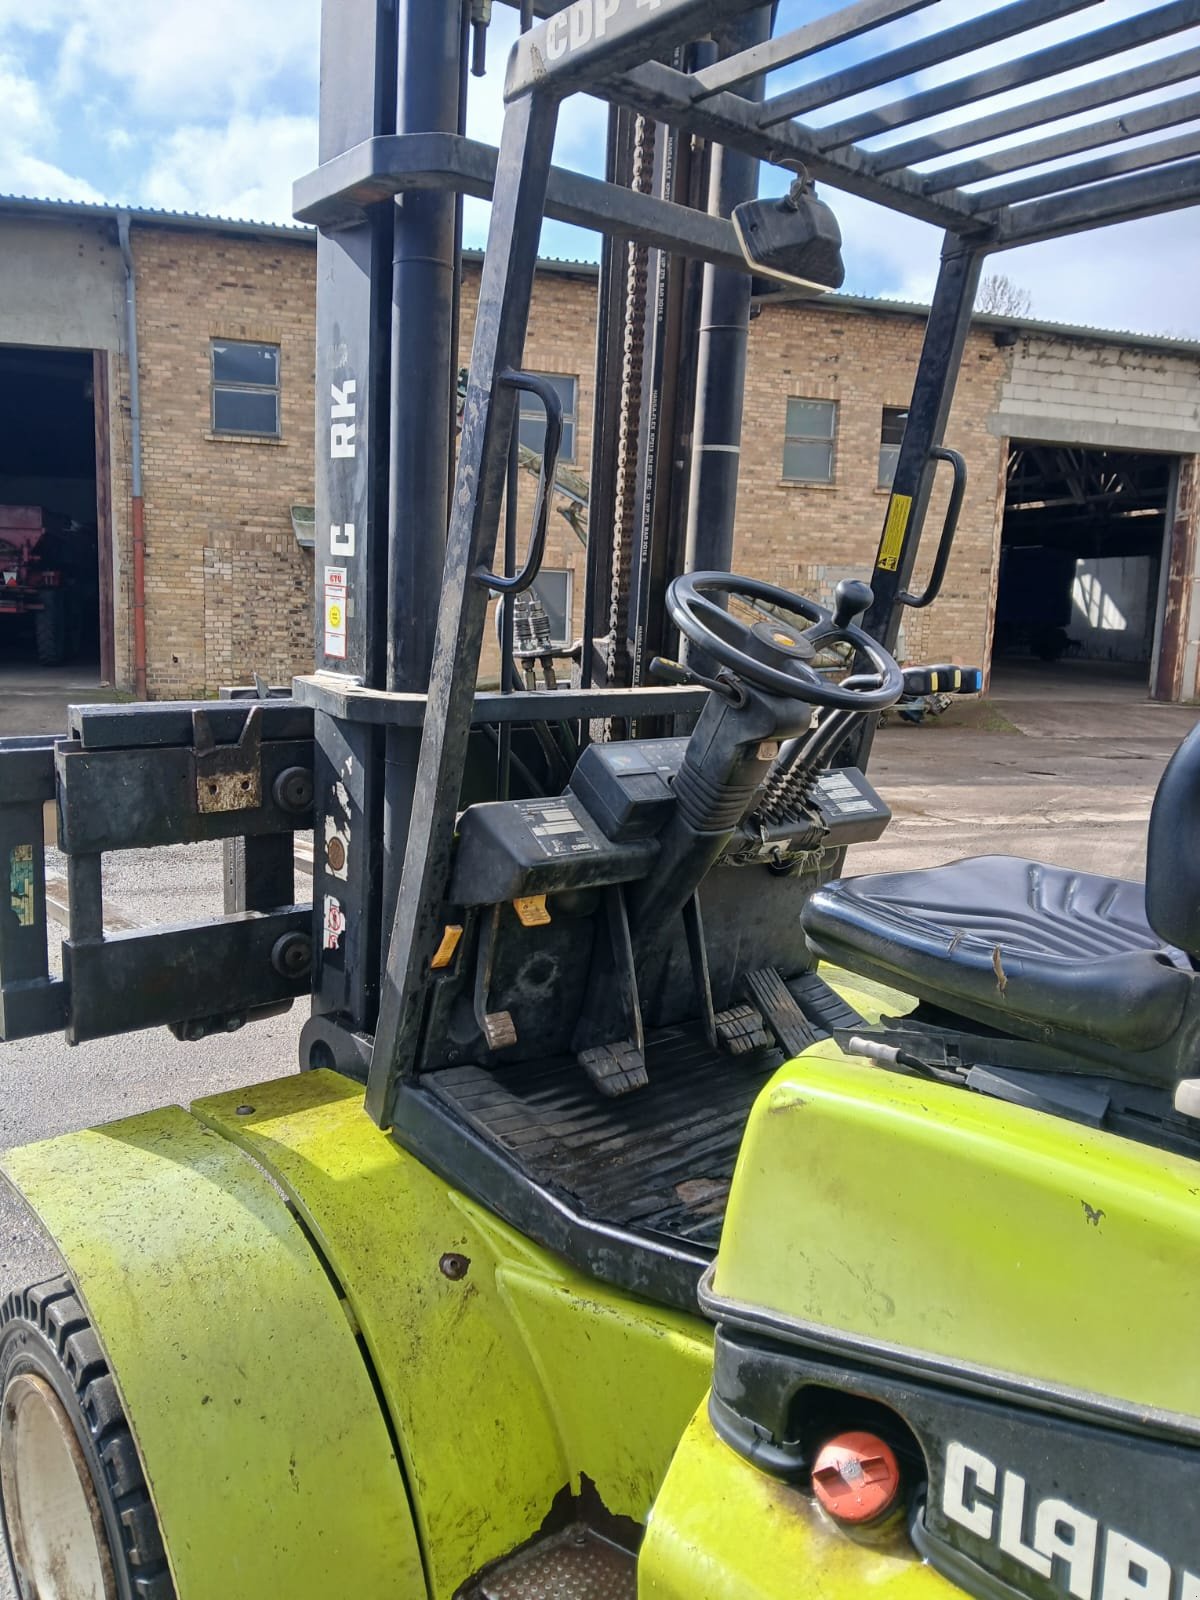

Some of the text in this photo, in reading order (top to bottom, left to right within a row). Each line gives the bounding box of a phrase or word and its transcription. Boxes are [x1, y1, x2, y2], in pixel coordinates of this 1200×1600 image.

[546, 0, 619, 61] CDP
[665, 136, 673, 180] HANSA-FLEX
[650, 389, 658, 430] HANSA-FLEX
[943, 1441, 1200, 1600] CLAR
